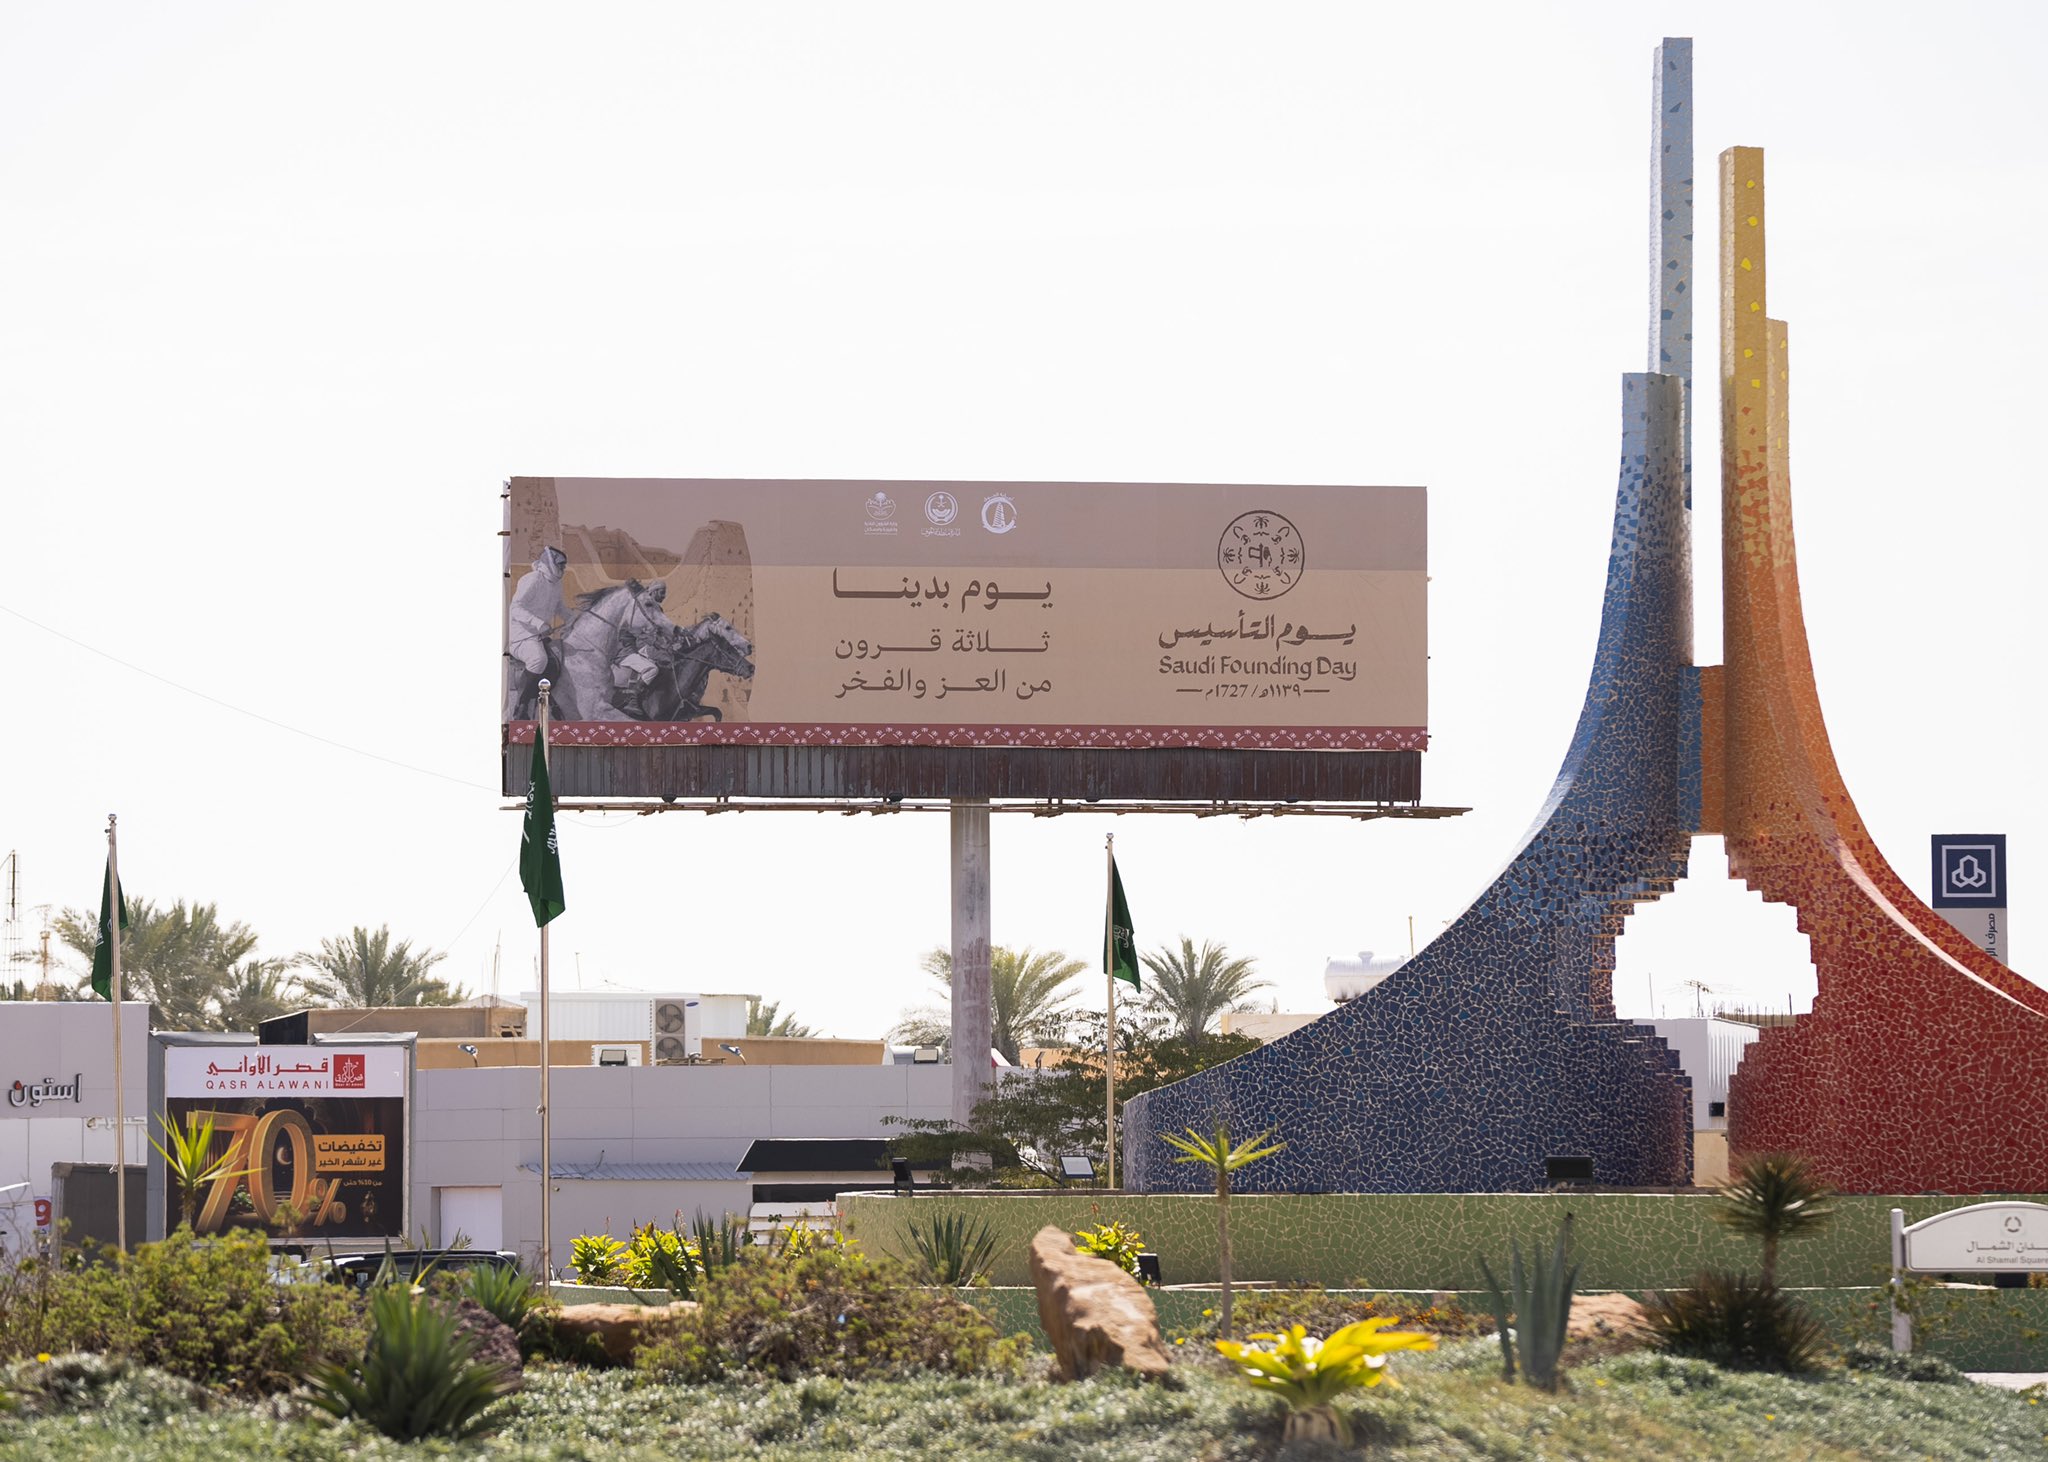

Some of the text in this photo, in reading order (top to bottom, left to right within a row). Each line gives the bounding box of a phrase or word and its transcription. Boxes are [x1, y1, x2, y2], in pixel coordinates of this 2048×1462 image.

[832, 567, 1054, 613] يوم بدينا
[1158, 609, 1357, 652] يوم التأسيس
[834, 628, 1050, 660] ثلاثة قرون
[1158, 655, 1357, 681] Saudi Founding Day
[834, 667, 1052, 700] من العز والفخر
[1985, 913, 1998, 945] مصرف
[206, 1054, 271, 1076] الأواني
[273, 1058, 329, 1076] قصر
[205, 1080, 329, 1090] QASR ALAWANI
[318, 1140, 382, 1154] تخفيضات
[1976, 1256, 1985, 1264] Al
[1987, 1255, 2018, 1264] Shamal
